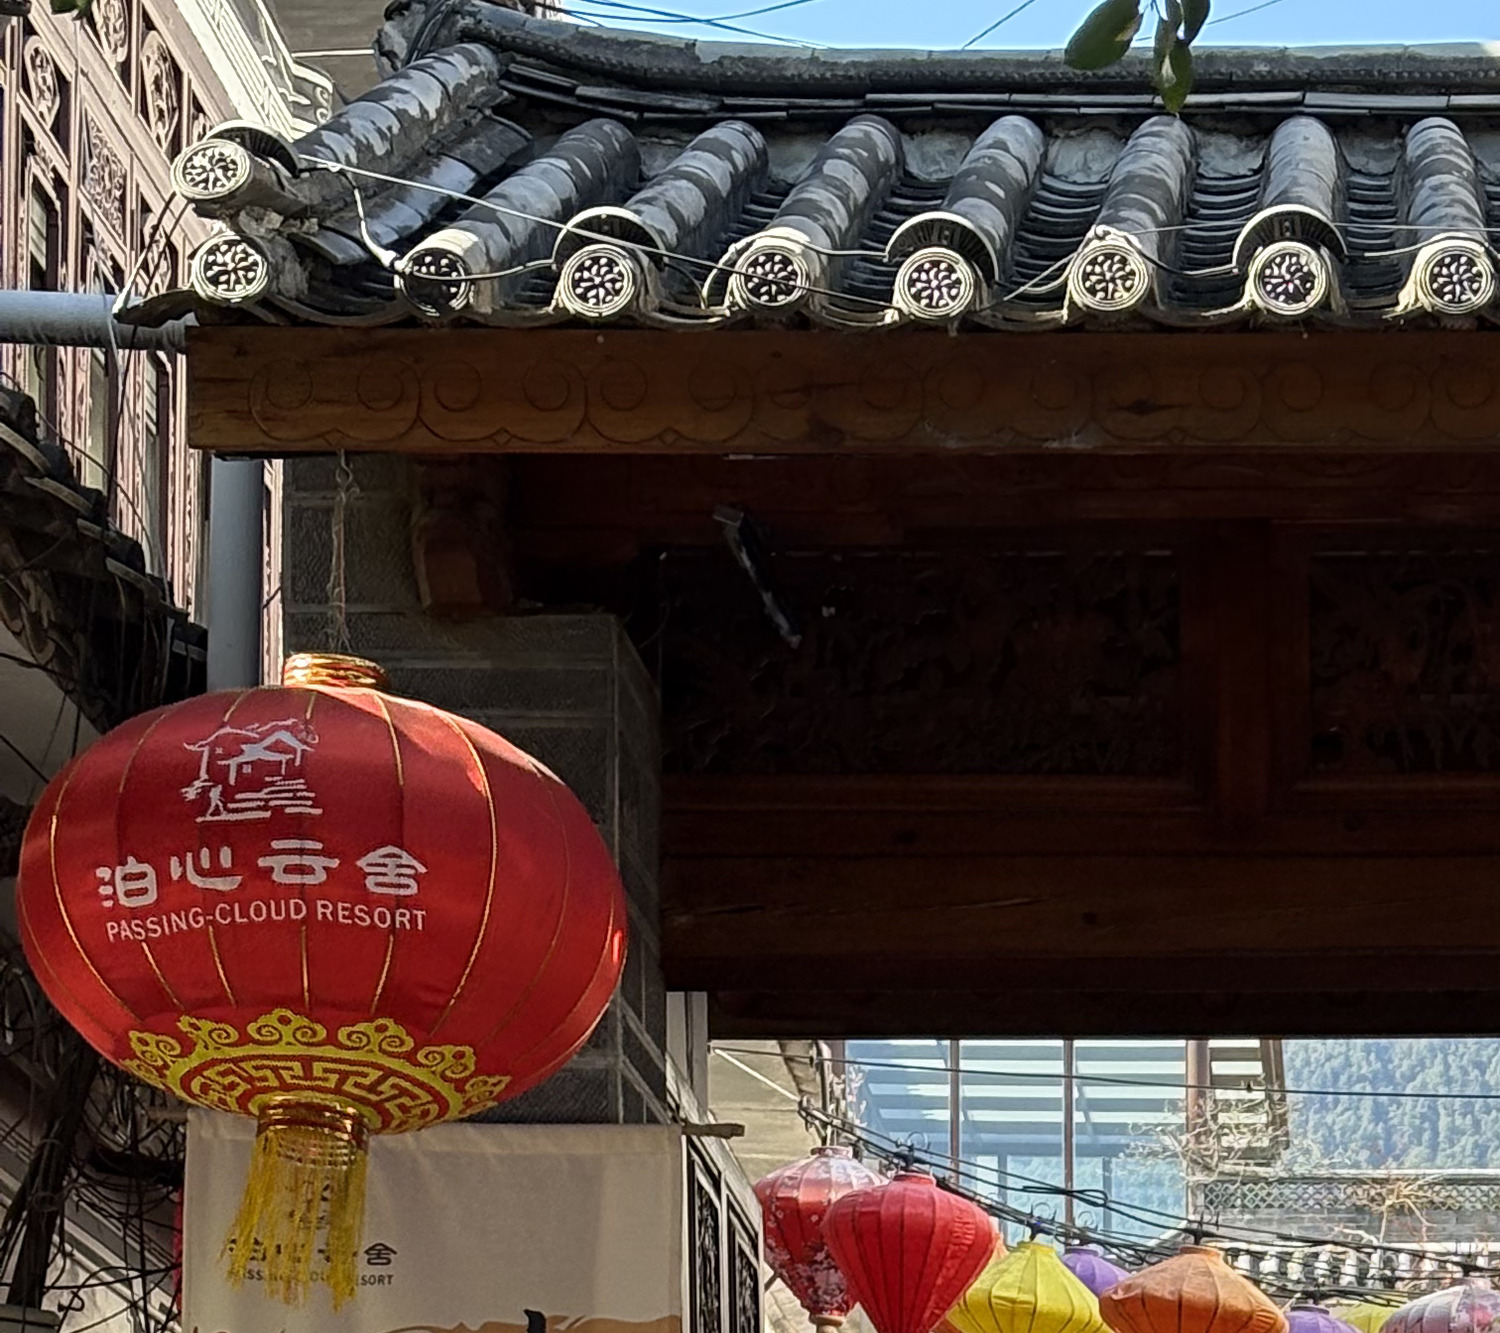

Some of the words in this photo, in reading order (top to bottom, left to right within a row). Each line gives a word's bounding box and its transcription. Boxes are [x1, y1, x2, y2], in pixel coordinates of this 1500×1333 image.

[96, 839, 428, 908] 泊心云舍
[106, 899, 307, 943] PASSING-CLOUD
[316, 899, 427, 931] RESORT
